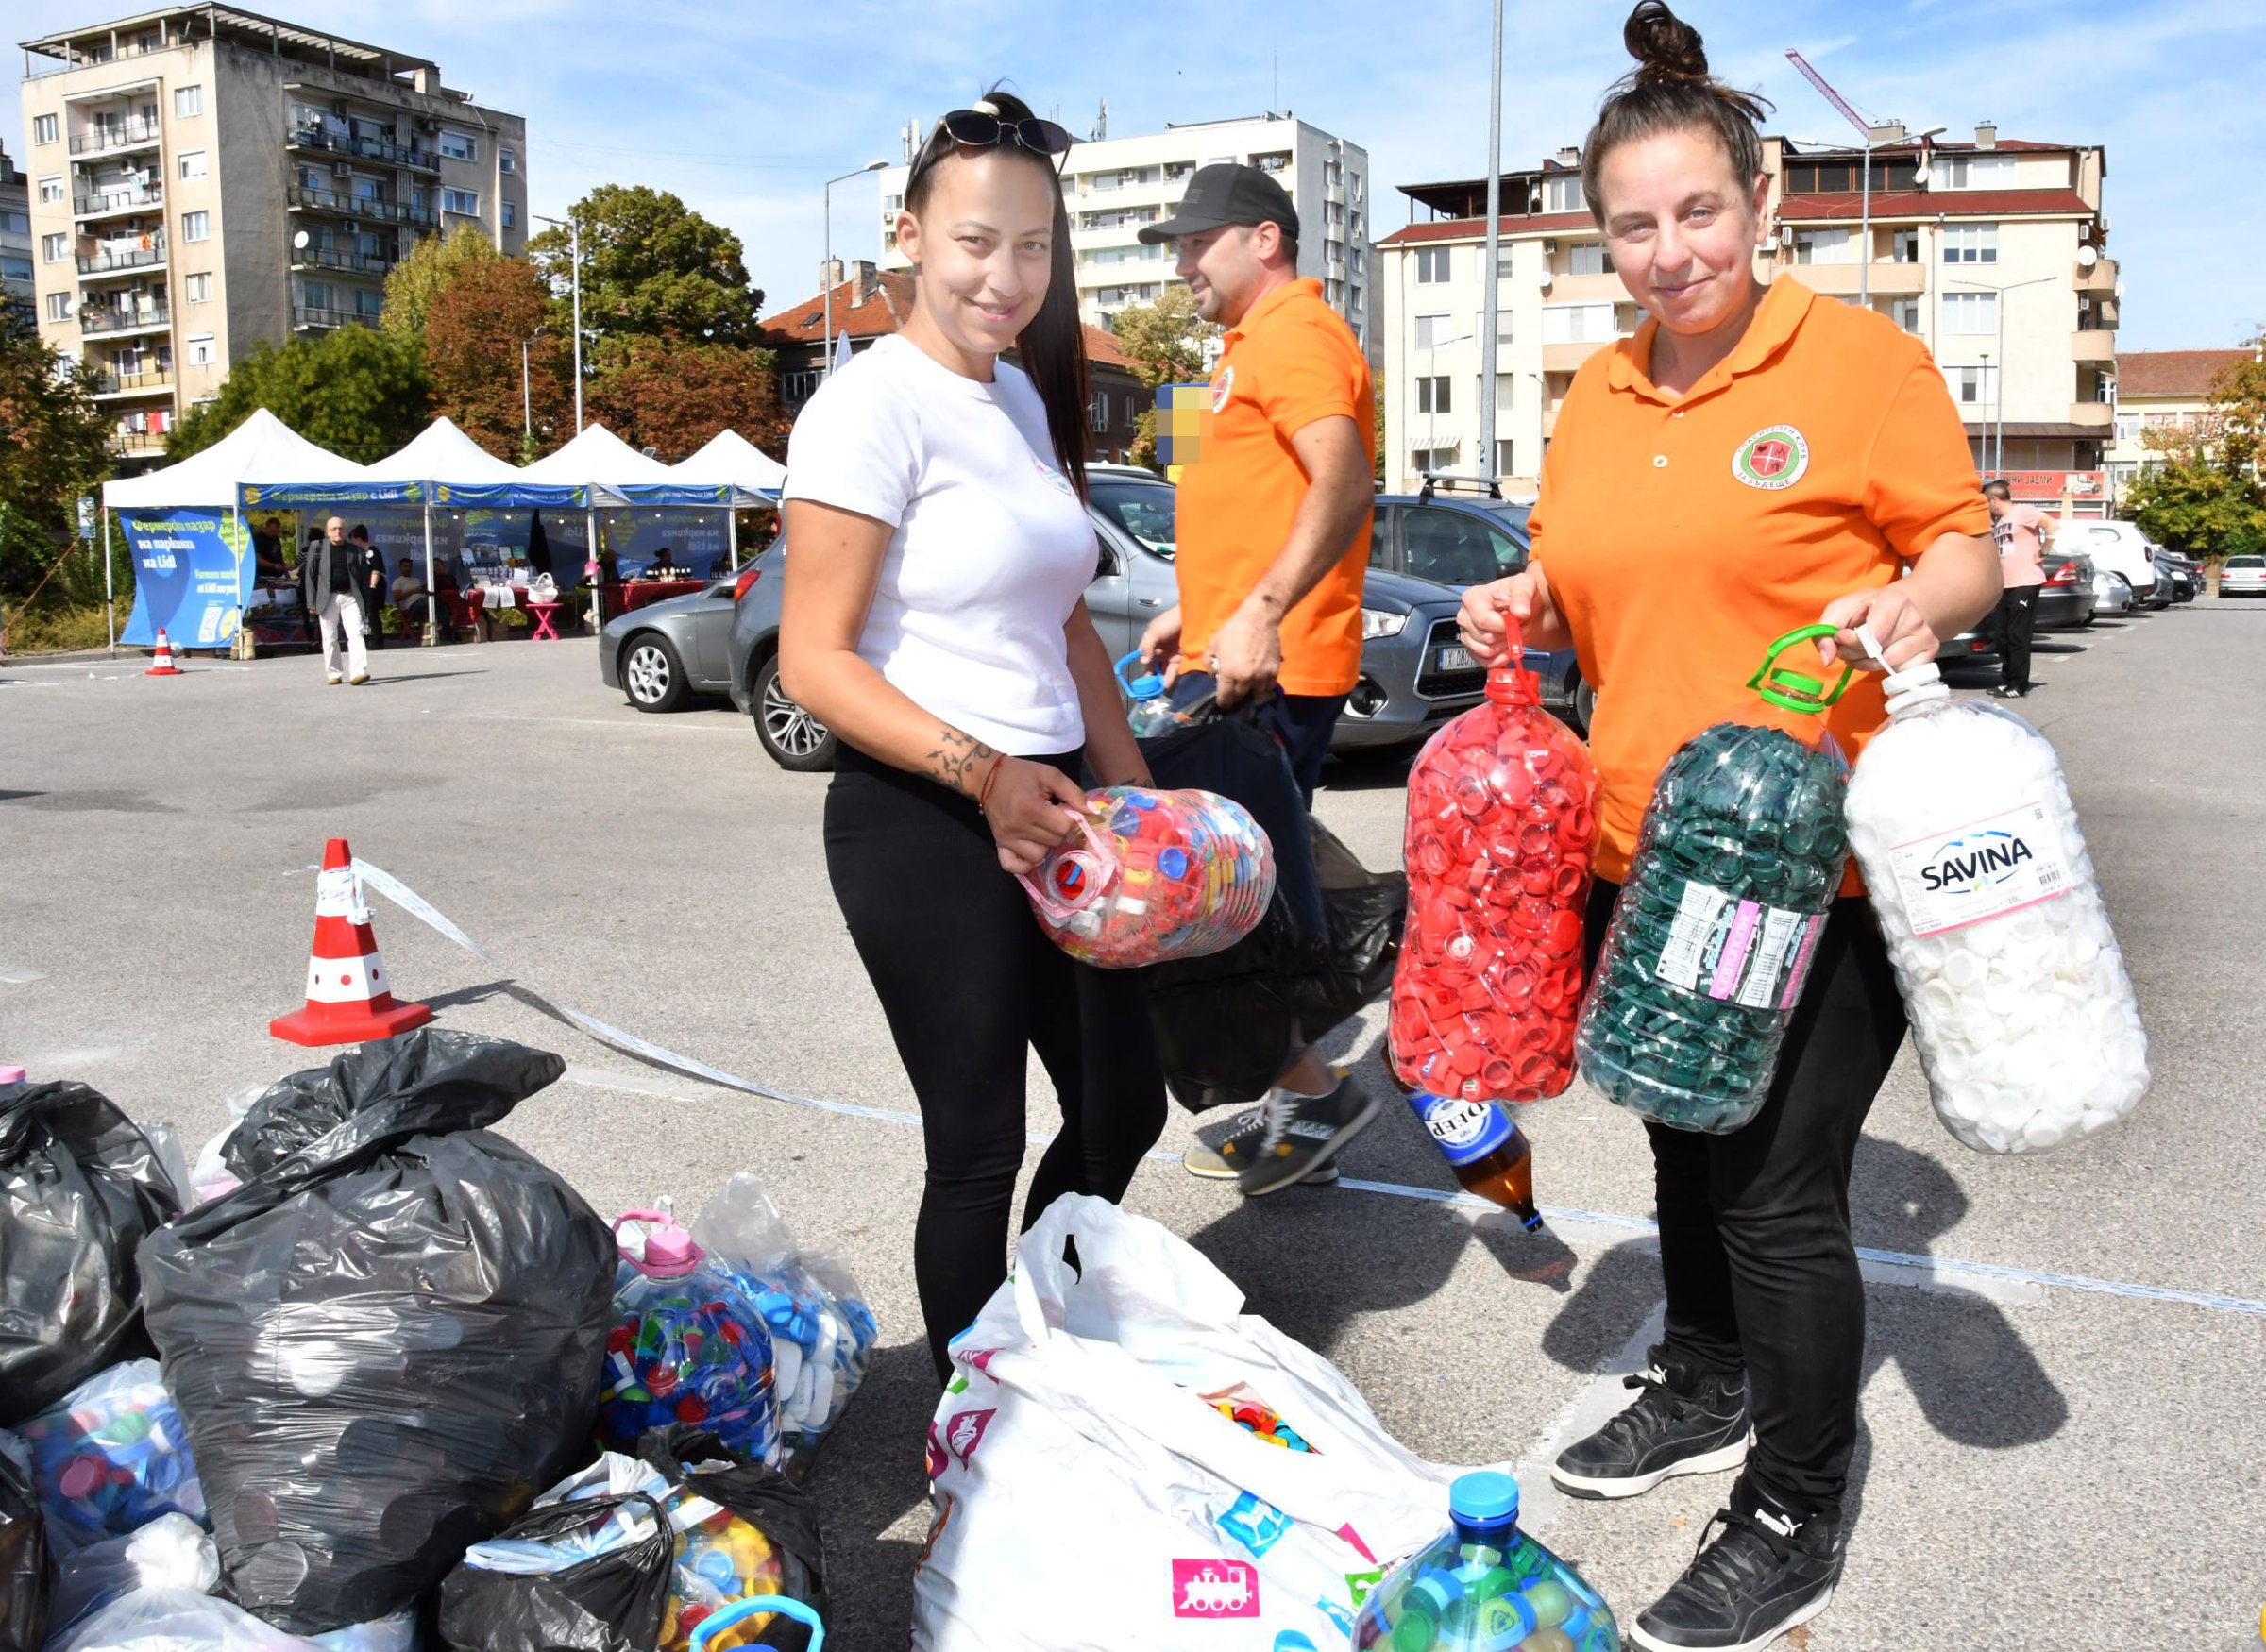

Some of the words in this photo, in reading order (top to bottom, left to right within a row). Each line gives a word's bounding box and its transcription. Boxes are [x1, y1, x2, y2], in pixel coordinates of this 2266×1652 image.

[1795, 435, 1807, 460] КЛУБ
[1748, 478, 1791, 489] БЪДЕЩЕ
[2025, 475, 2052, 484] ЗАЕМИ
[271, 491, 334, 503] Фермерски
[337, 491, 368, 502] пазар
[378, 488, 398, 499] Lidl
[137, 539, 152, 549] на
[153, 536, 195, 552] паркинга
[143, 558, 157, 568] на
[157, 554, 178, 568] Lidl
[1920, 837, 2033, 891] SAVINA
[1432, 1102, 1486, 1137] DEEP
